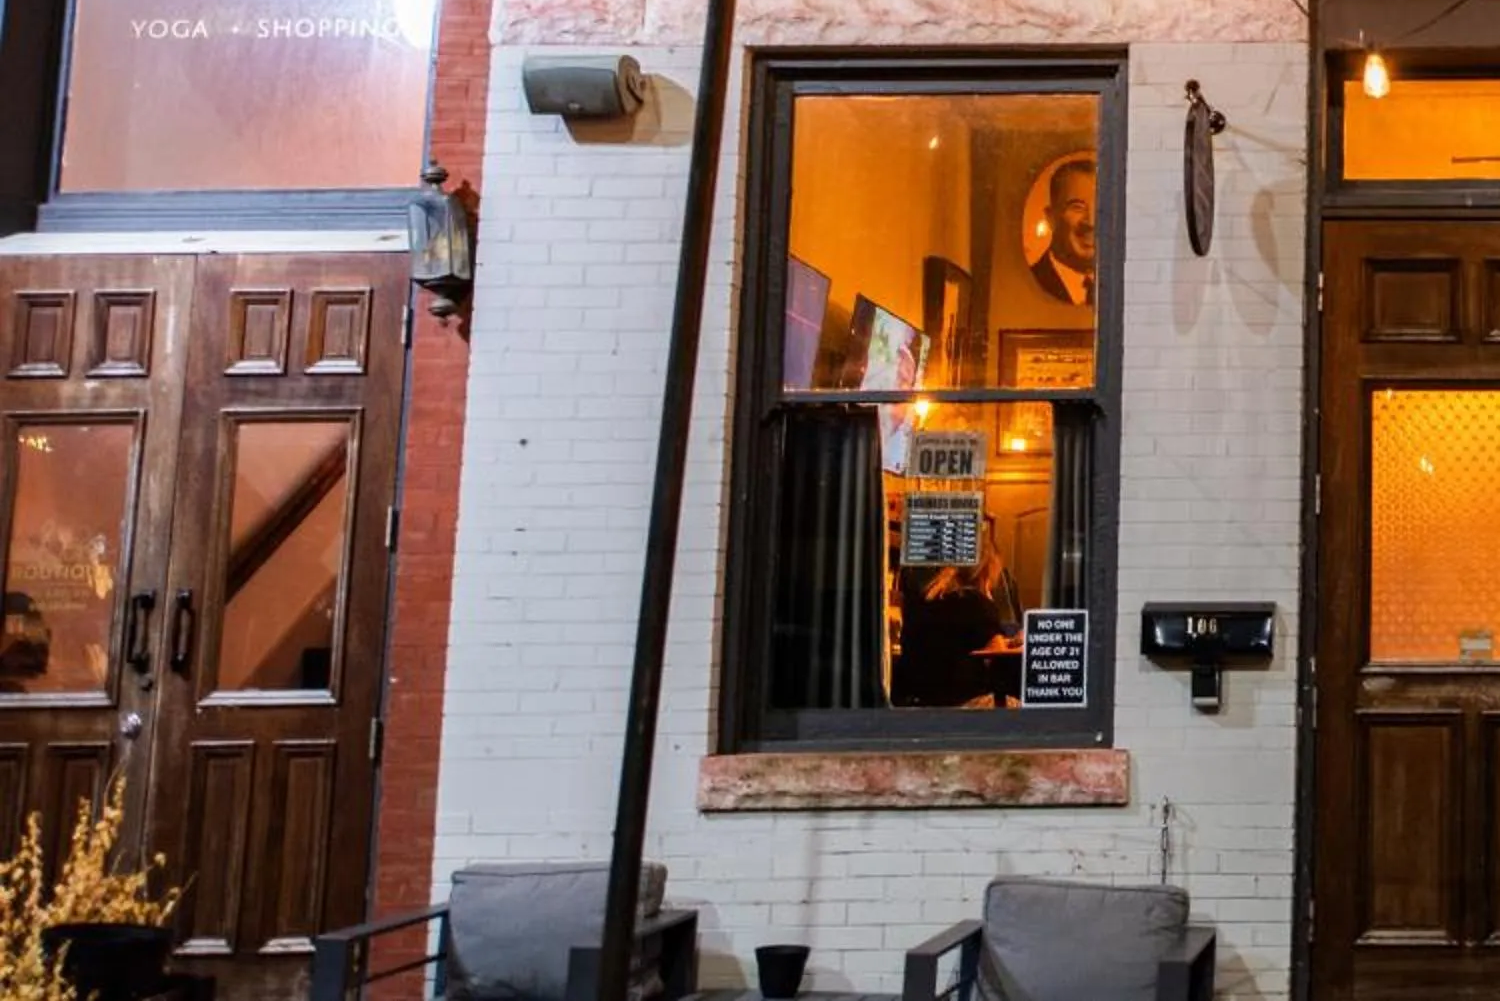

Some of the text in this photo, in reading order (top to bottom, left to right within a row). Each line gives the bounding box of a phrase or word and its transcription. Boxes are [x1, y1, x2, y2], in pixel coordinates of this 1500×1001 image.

[131, 19, 209, 39] YOGA
[919, 449, 973, 475] OPEN
[1037, 620, 1075, 630] NO ONE
[1029, 633, 1082, 642] UNDER THE
[1030, 647, 1080, 656] AGE OF 21
[1031, 660, 1079, 670] ALLOWED
[1038, 674, 1071, 683] IN BAR
[1027, 687, 1083, 697] THANK YOU
